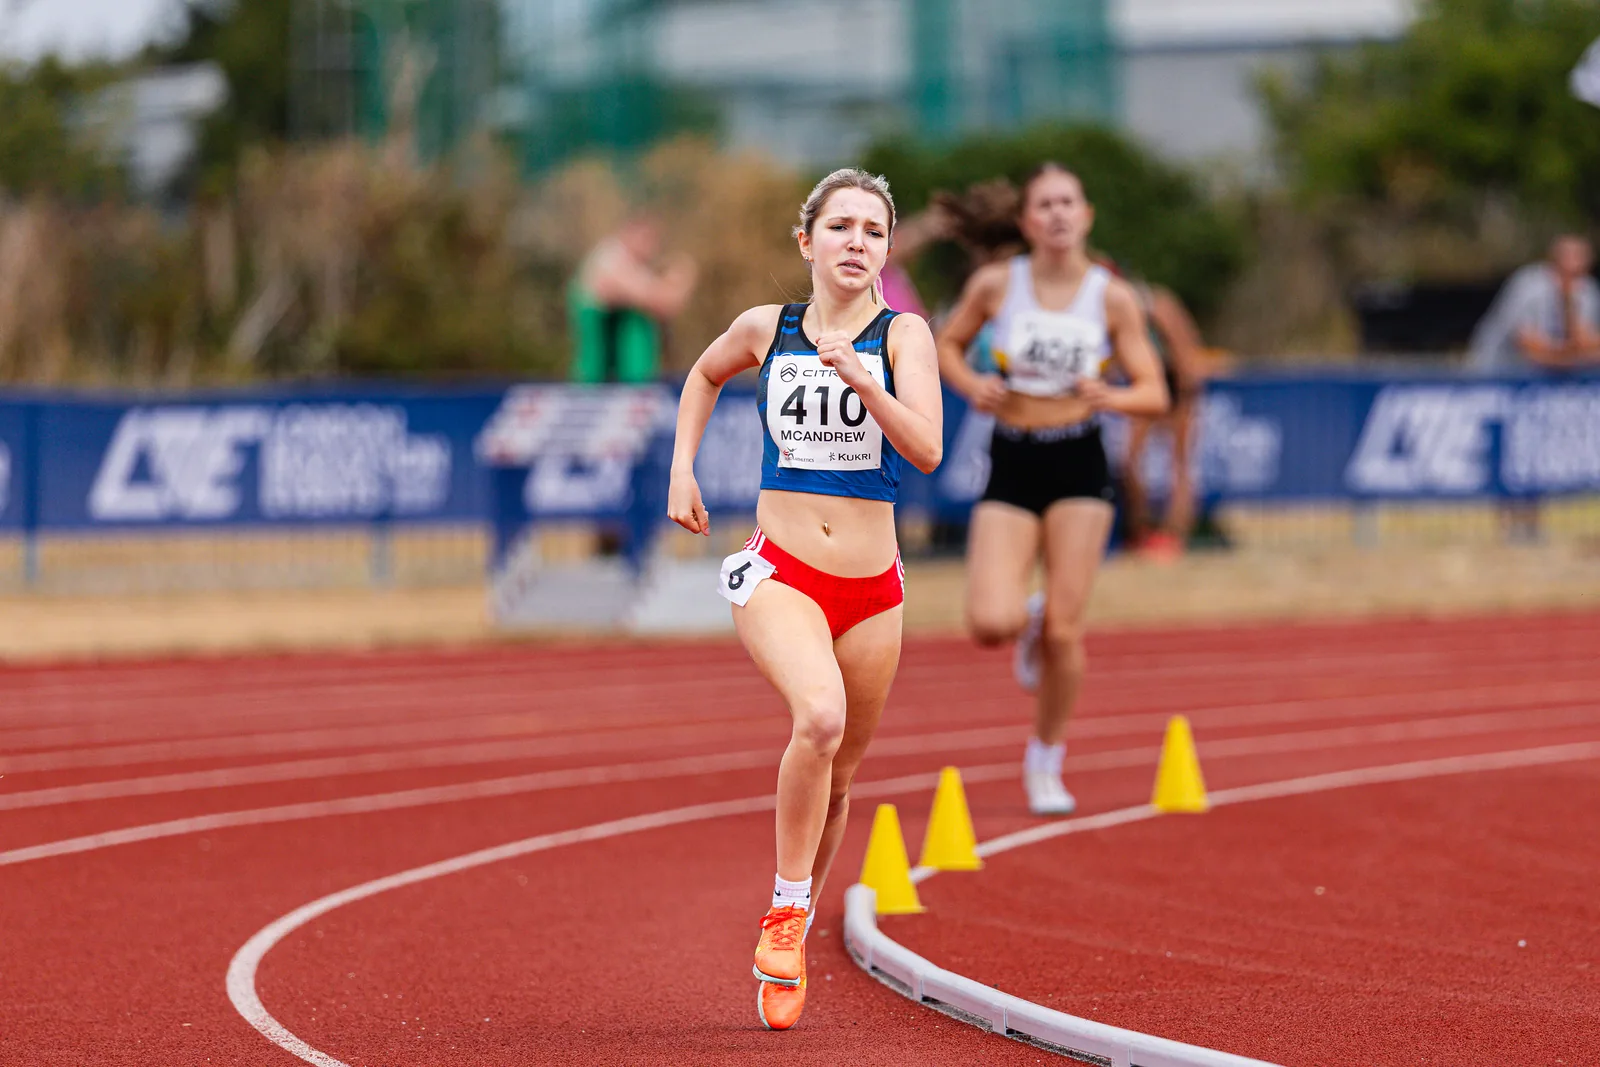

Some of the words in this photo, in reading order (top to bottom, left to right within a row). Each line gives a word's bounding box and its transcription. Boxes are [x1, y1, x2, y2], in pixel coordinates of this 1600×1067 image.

[780, 385, 867, 427] 410
[780, 430, 866, 442] MCANDREW
[838, 453, 871, 461] KUKRI
[728, 561, 752, 590] 6
